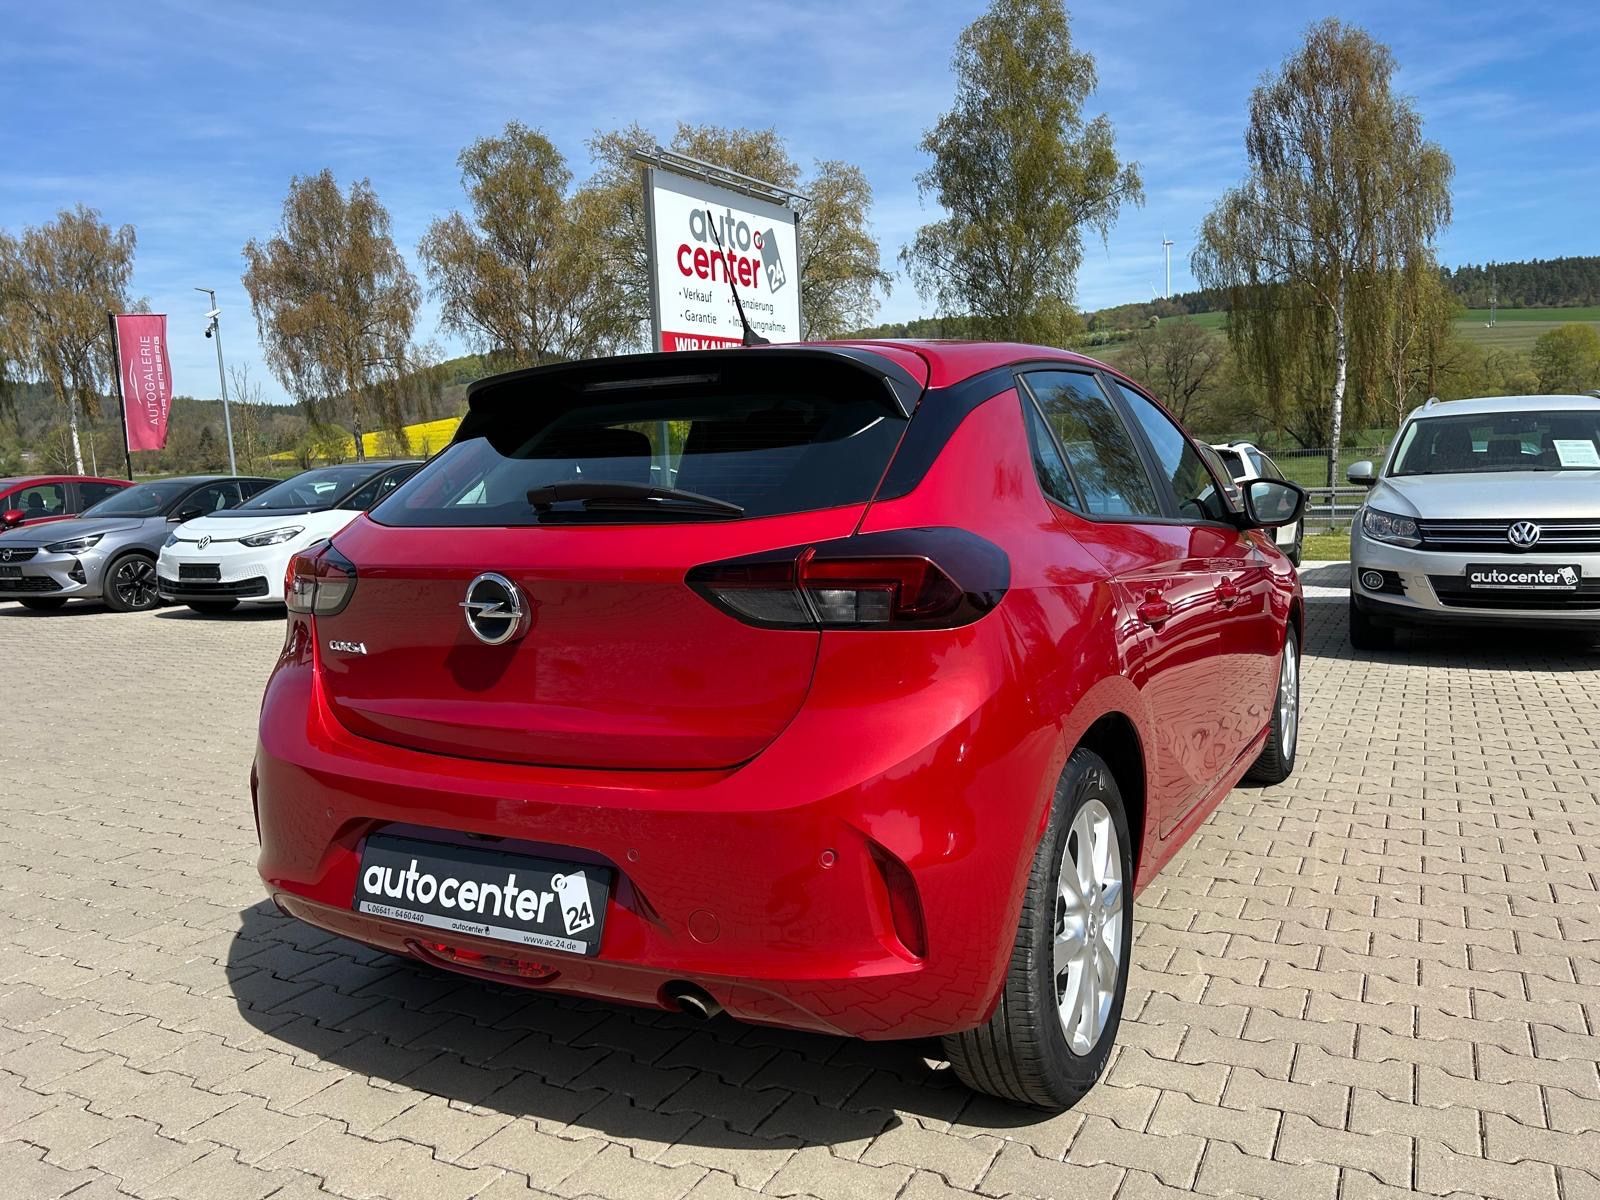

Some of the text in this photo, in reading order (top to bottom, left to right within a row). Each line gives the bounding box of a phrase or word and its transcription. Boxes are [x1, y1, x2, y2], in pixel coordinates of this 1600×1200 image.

[689, 208, 751, 251] auto
[677, 244, 760, 288] center
[683, 287, 712, 303] Verkauf
[685, 310, 717, 324] Garantie
[140, 335, 159, 425] AUTOGALERIE
[1470, 569, 1560, 583] autocenter
[363, 859, 555, 923] autocenter
[566, 901, 592, 931] 24
[452, 922, 484, 935] autocenter
[523, 936, 577, 951] www.ac-24.de
